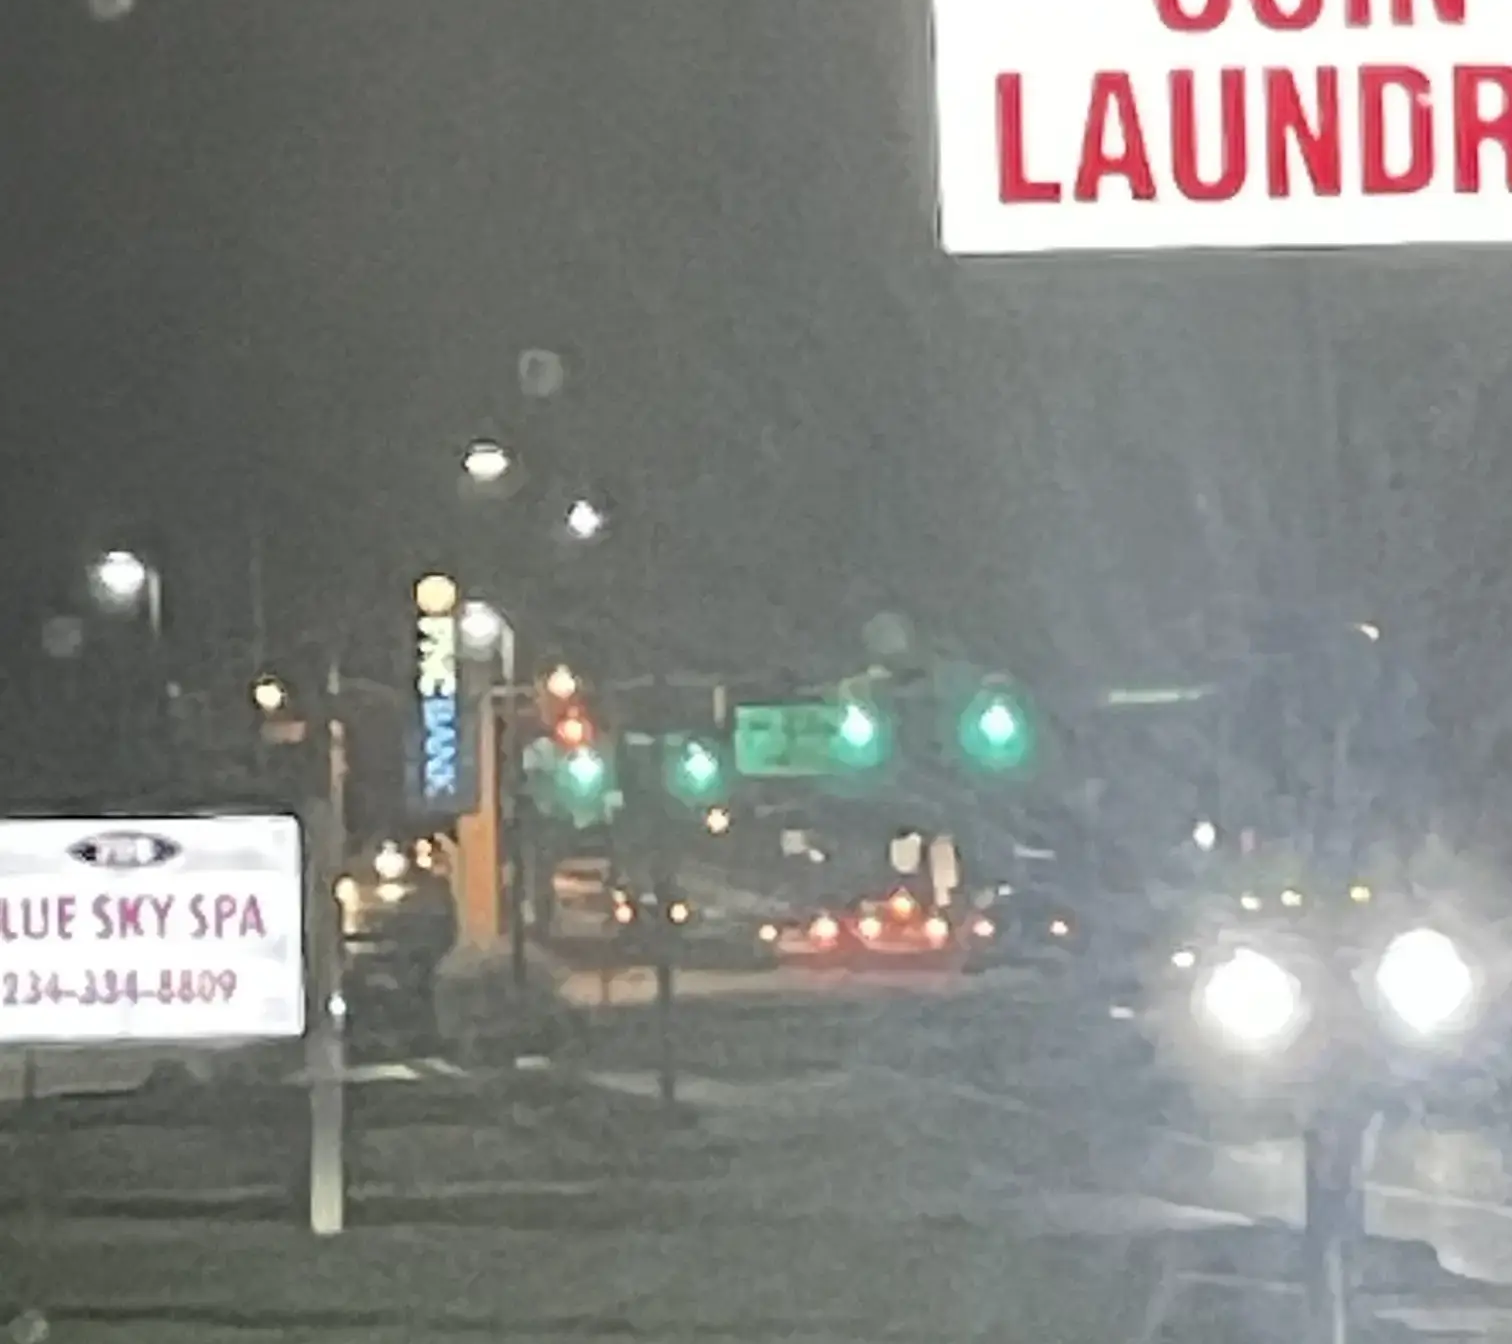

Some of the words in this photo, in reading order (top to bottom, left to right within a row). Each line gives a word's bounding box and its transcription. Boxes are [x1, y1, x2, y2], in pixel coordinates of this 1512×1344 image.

[0, 895, 76, 942] LUE
[91, 892, 175, 940] SKY
[188, 893, 267, 940] SPA
